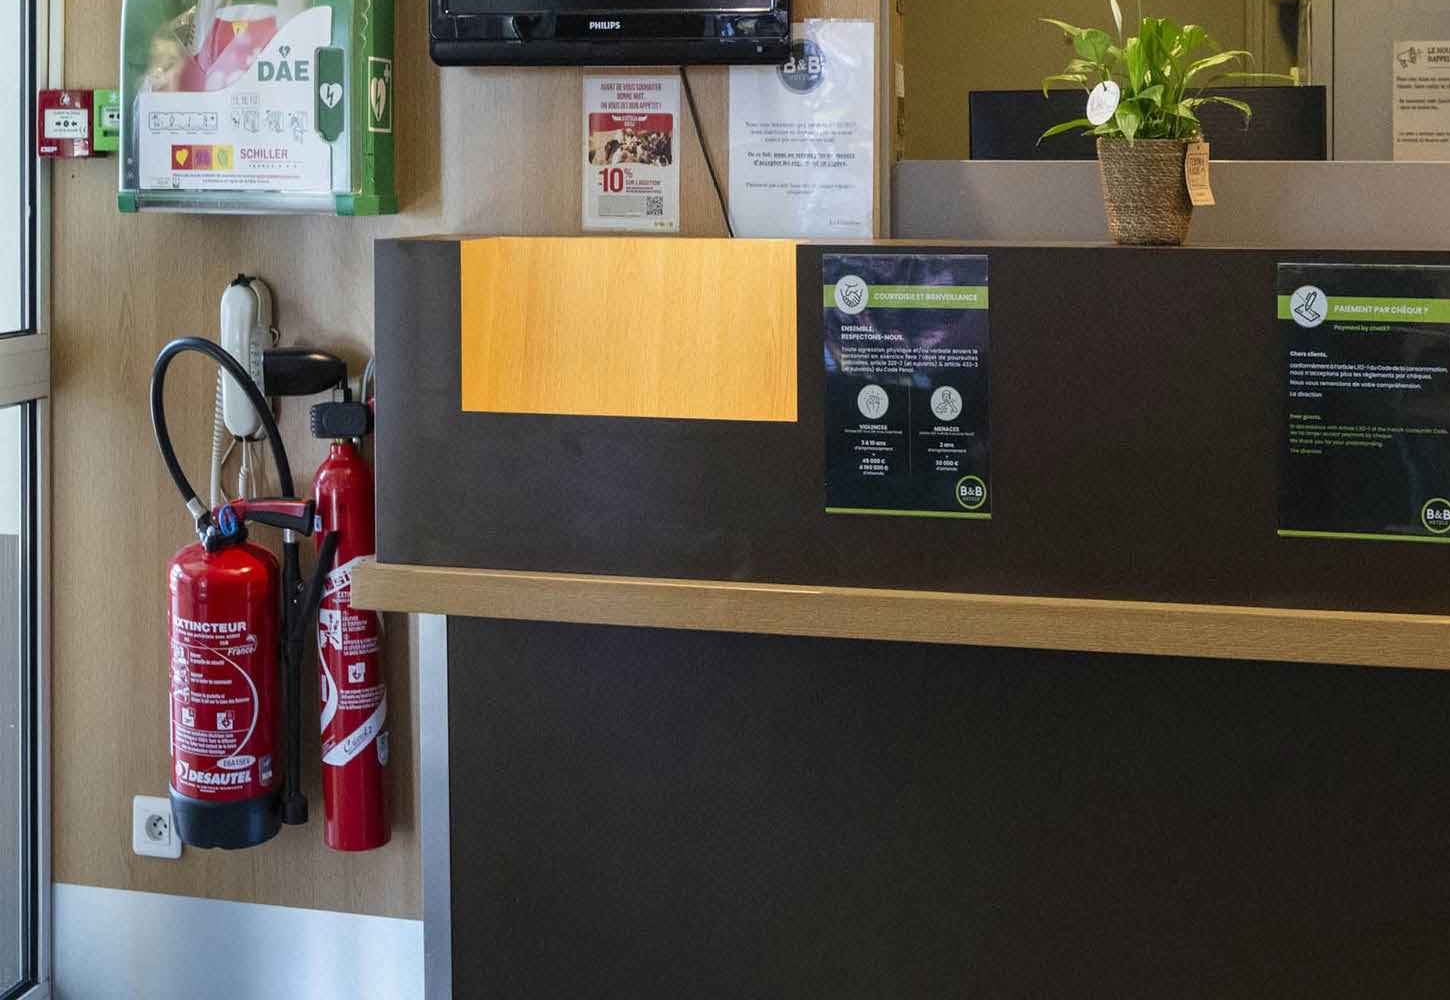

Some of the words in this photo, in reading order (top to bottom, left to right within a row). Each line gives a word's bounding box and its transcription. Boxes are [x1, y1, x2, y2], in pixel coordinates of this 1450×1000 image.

[588, 20, 621, 30] PHILIPS
[257, 59, 311, 82] DAE
[240, 148, 289, 160] SCHILLER
[1334, 304, 1373, 314] PAIEMENT
[1373, 305, 1390, 314] PAR
[960, 486, 983, 497] B&B
[1426, 509, 1450, 521] B&B
[174, 616, 247, 633] XTINCTEUR
[227, 646, 254, 656] France
[189, 769, 252, 786] DESAUTEL
